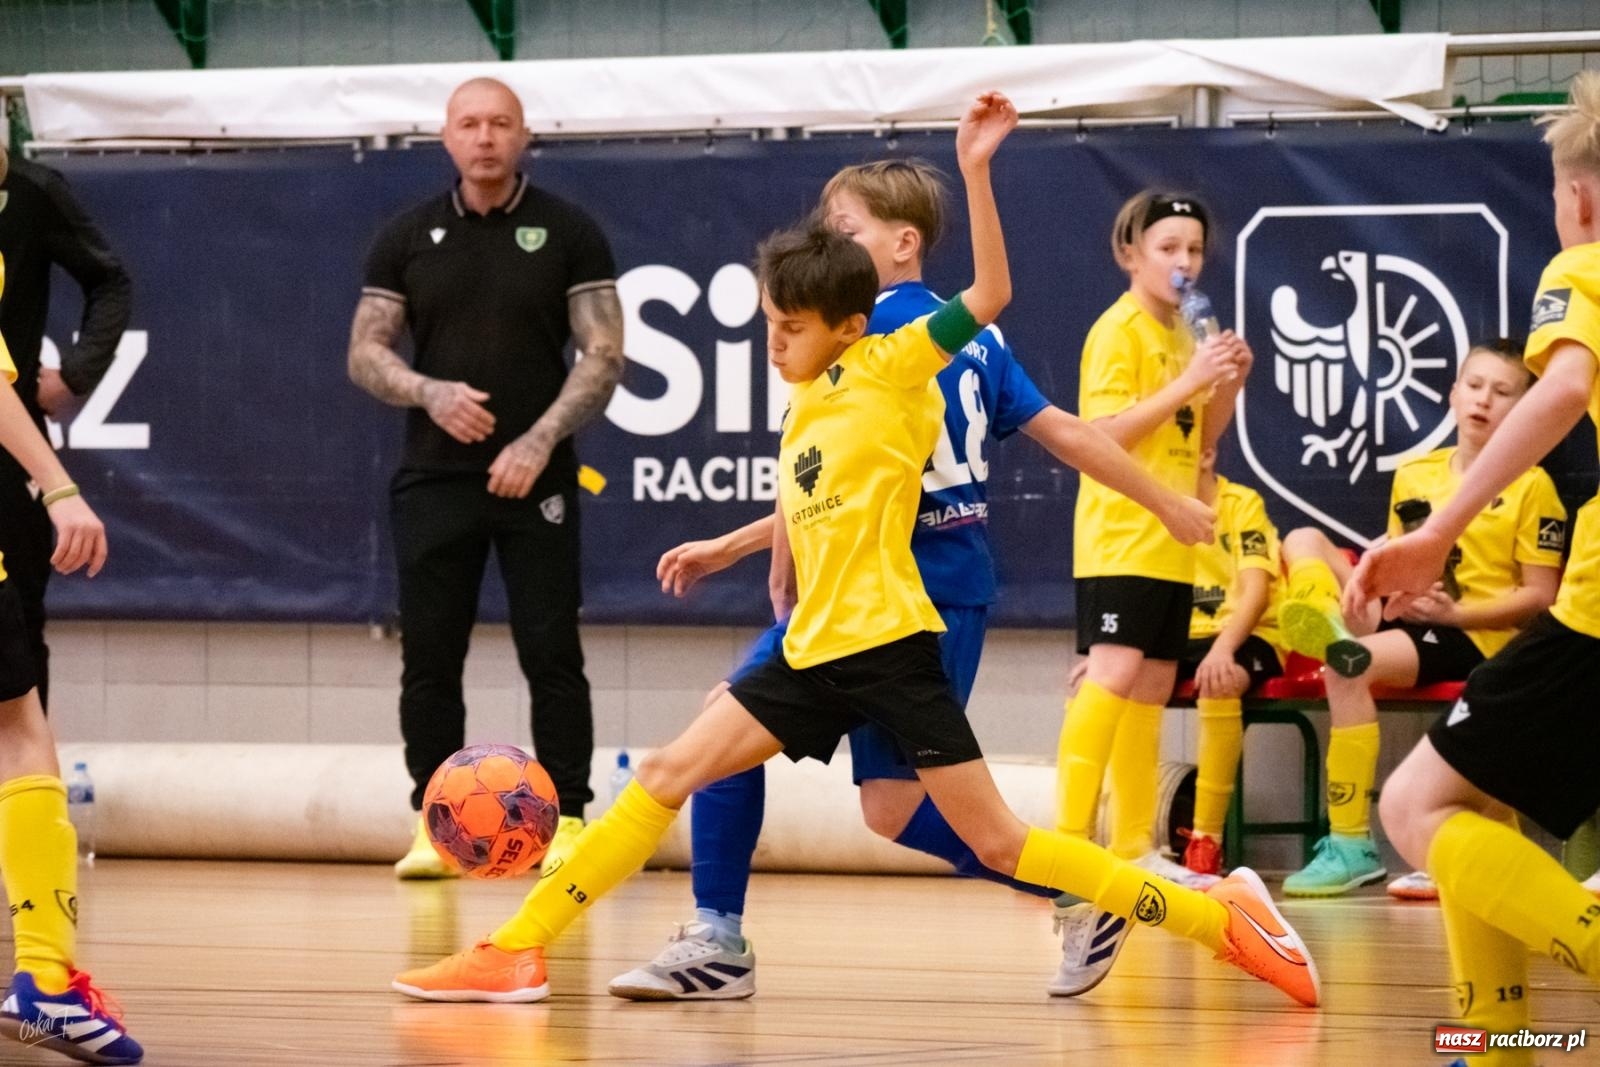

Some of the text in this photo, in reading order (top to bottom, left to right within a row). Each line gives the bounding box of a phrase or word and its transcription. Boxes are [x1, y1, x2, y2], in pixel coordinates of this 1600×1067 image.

[1101, 613, 1119, 634] 35
[565, 883, 588, 904] 19
[1576, 904, 1600, 929] 19
[1496, 985, 1523, 1002] 19
